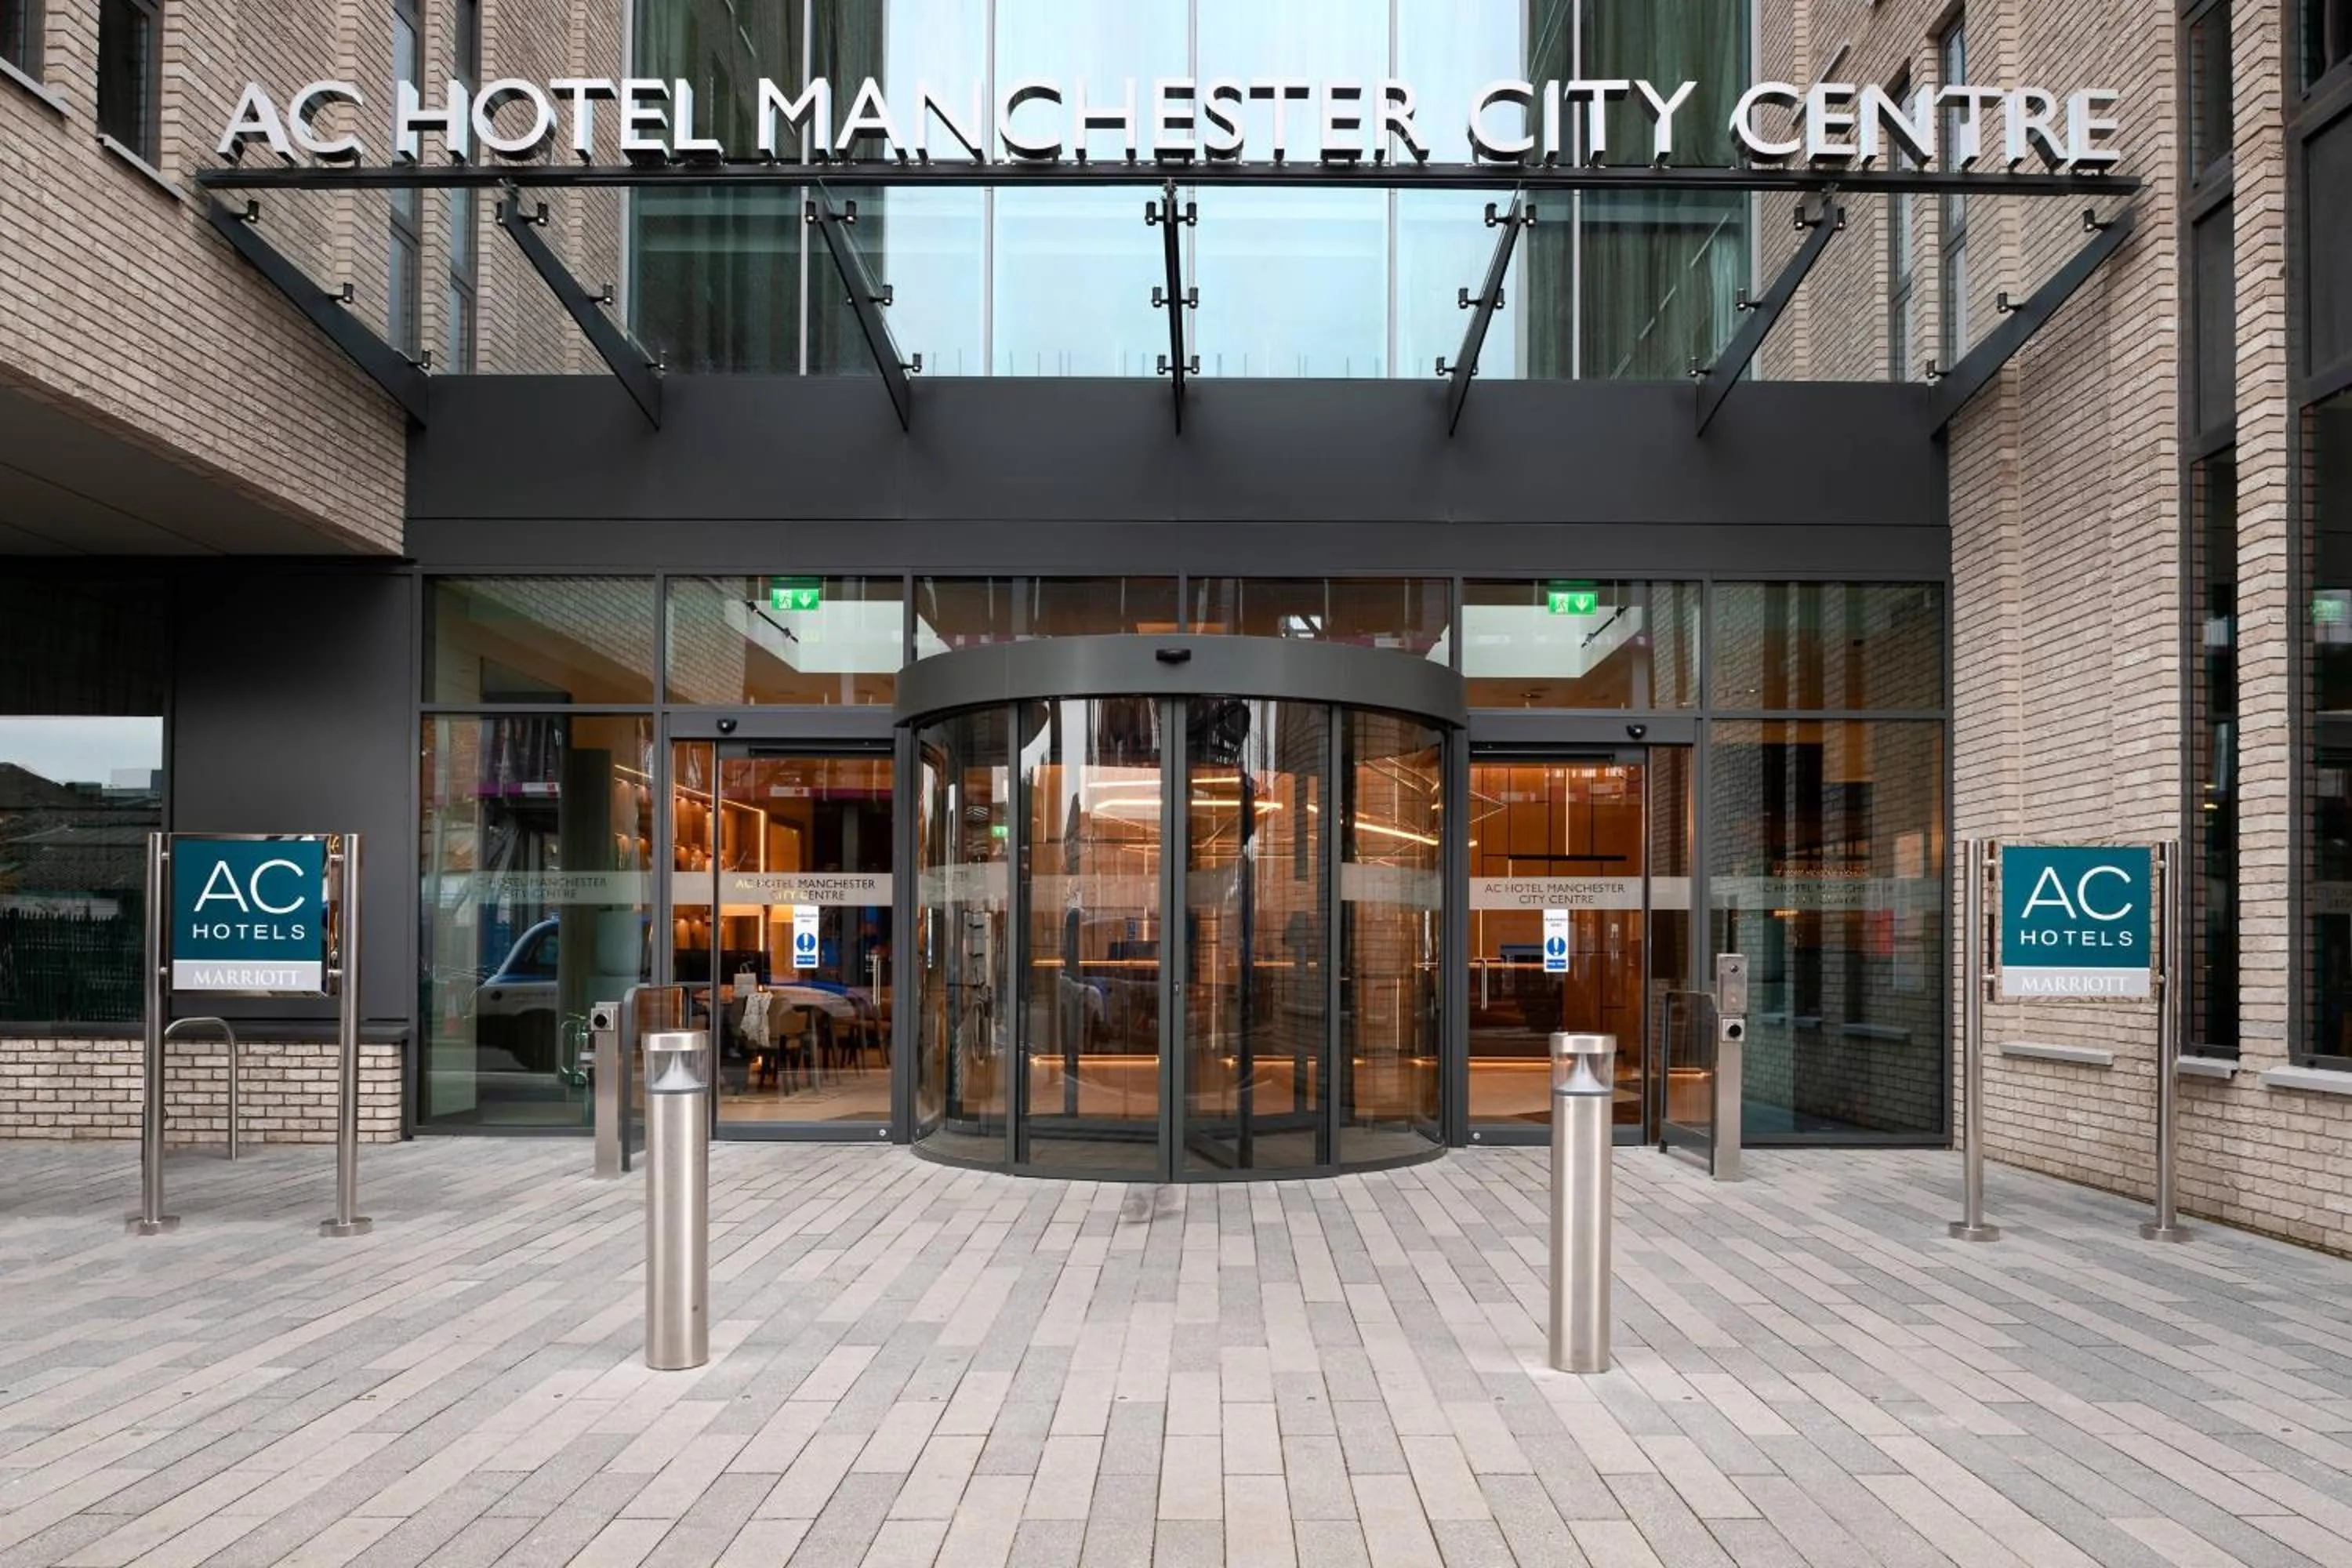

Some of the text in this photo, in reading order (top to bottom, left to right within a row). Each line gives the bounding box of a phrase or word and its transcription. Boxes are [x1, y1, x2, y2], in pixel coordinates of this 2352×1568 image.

[216, 76, 2122, 167] AC HOTEL MANCHESTER CITY CENTRE
[194, 858, 306, 914] AC
[797, 879, 876, 890] MANCHESTER
[1484, 884, 1625, 894] AC HOTEL MANCHESTER
[800, 890, 845, 901] CENTRE
[1519, 894, 1594, 904] CITY CENTRE
[2020, 866, 2133, 921] AC
[192, 924, 305, 940] HOTELS
[2020, 930, 2132, 946] HOTELS
[193, 969, 301, 985] MARRIOTT
[2021, 975, 2130, 993] MARRIOTT
